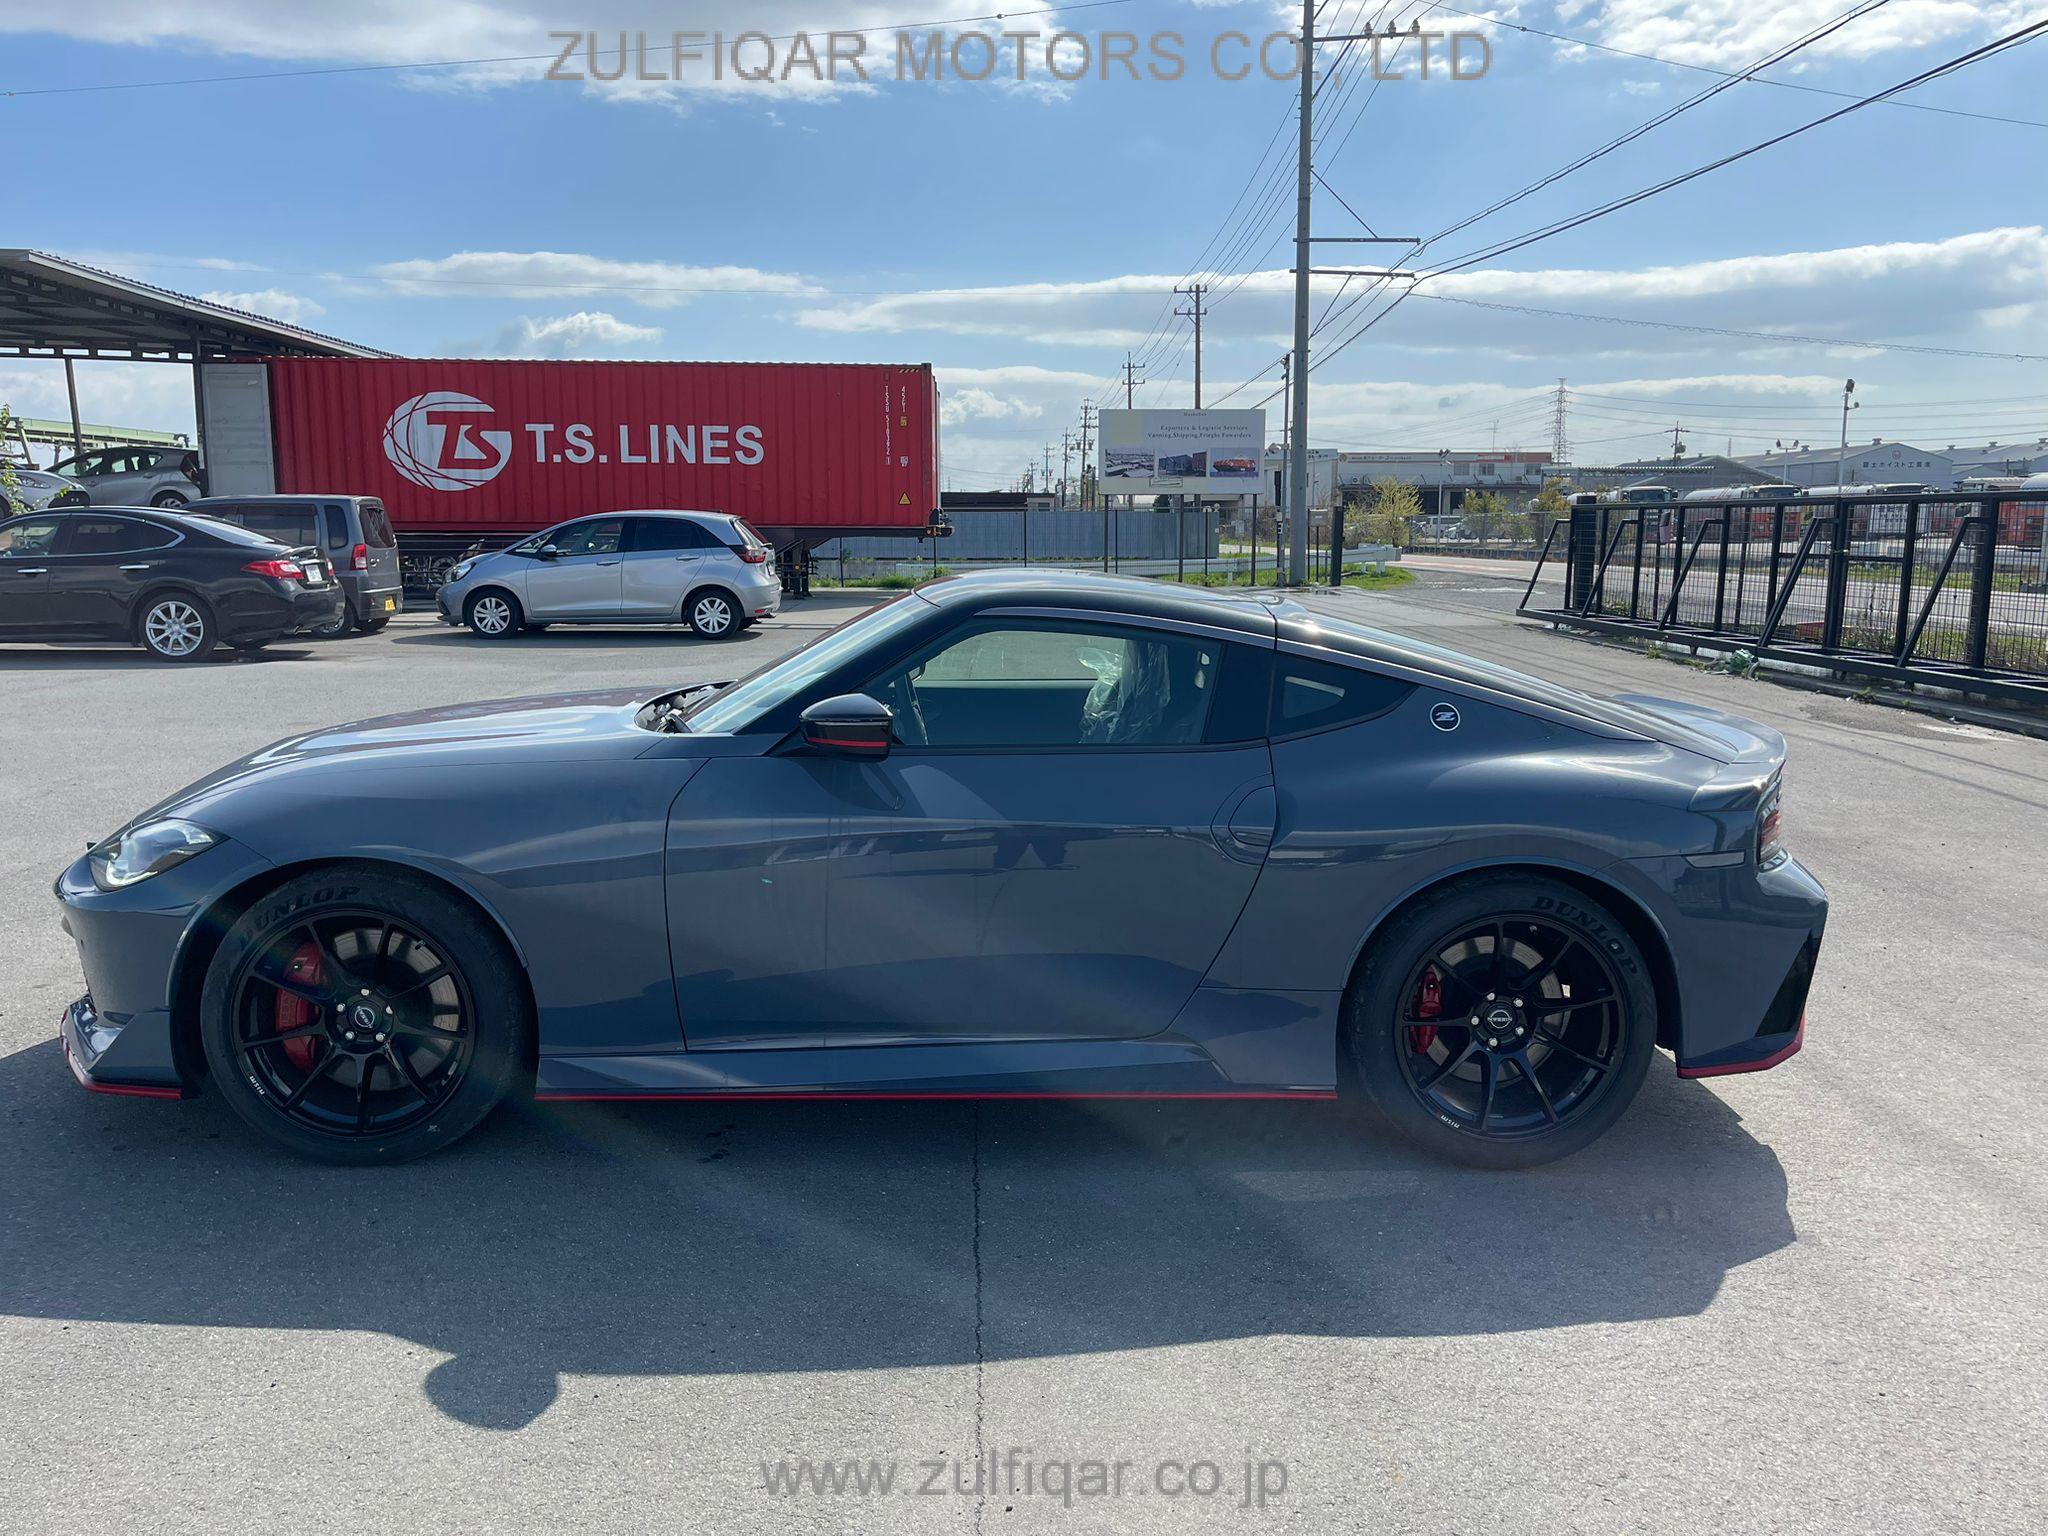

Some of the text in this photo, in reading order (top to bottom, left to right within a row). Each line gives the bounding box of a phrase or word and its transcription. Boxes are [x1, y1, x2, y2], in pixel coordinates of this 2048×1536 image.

[525, 423, 765, 466] T.S. LINES
[1531, 895, 1638, 974] DUNLOP
[1438, 1113, 1460, 1129] nism
